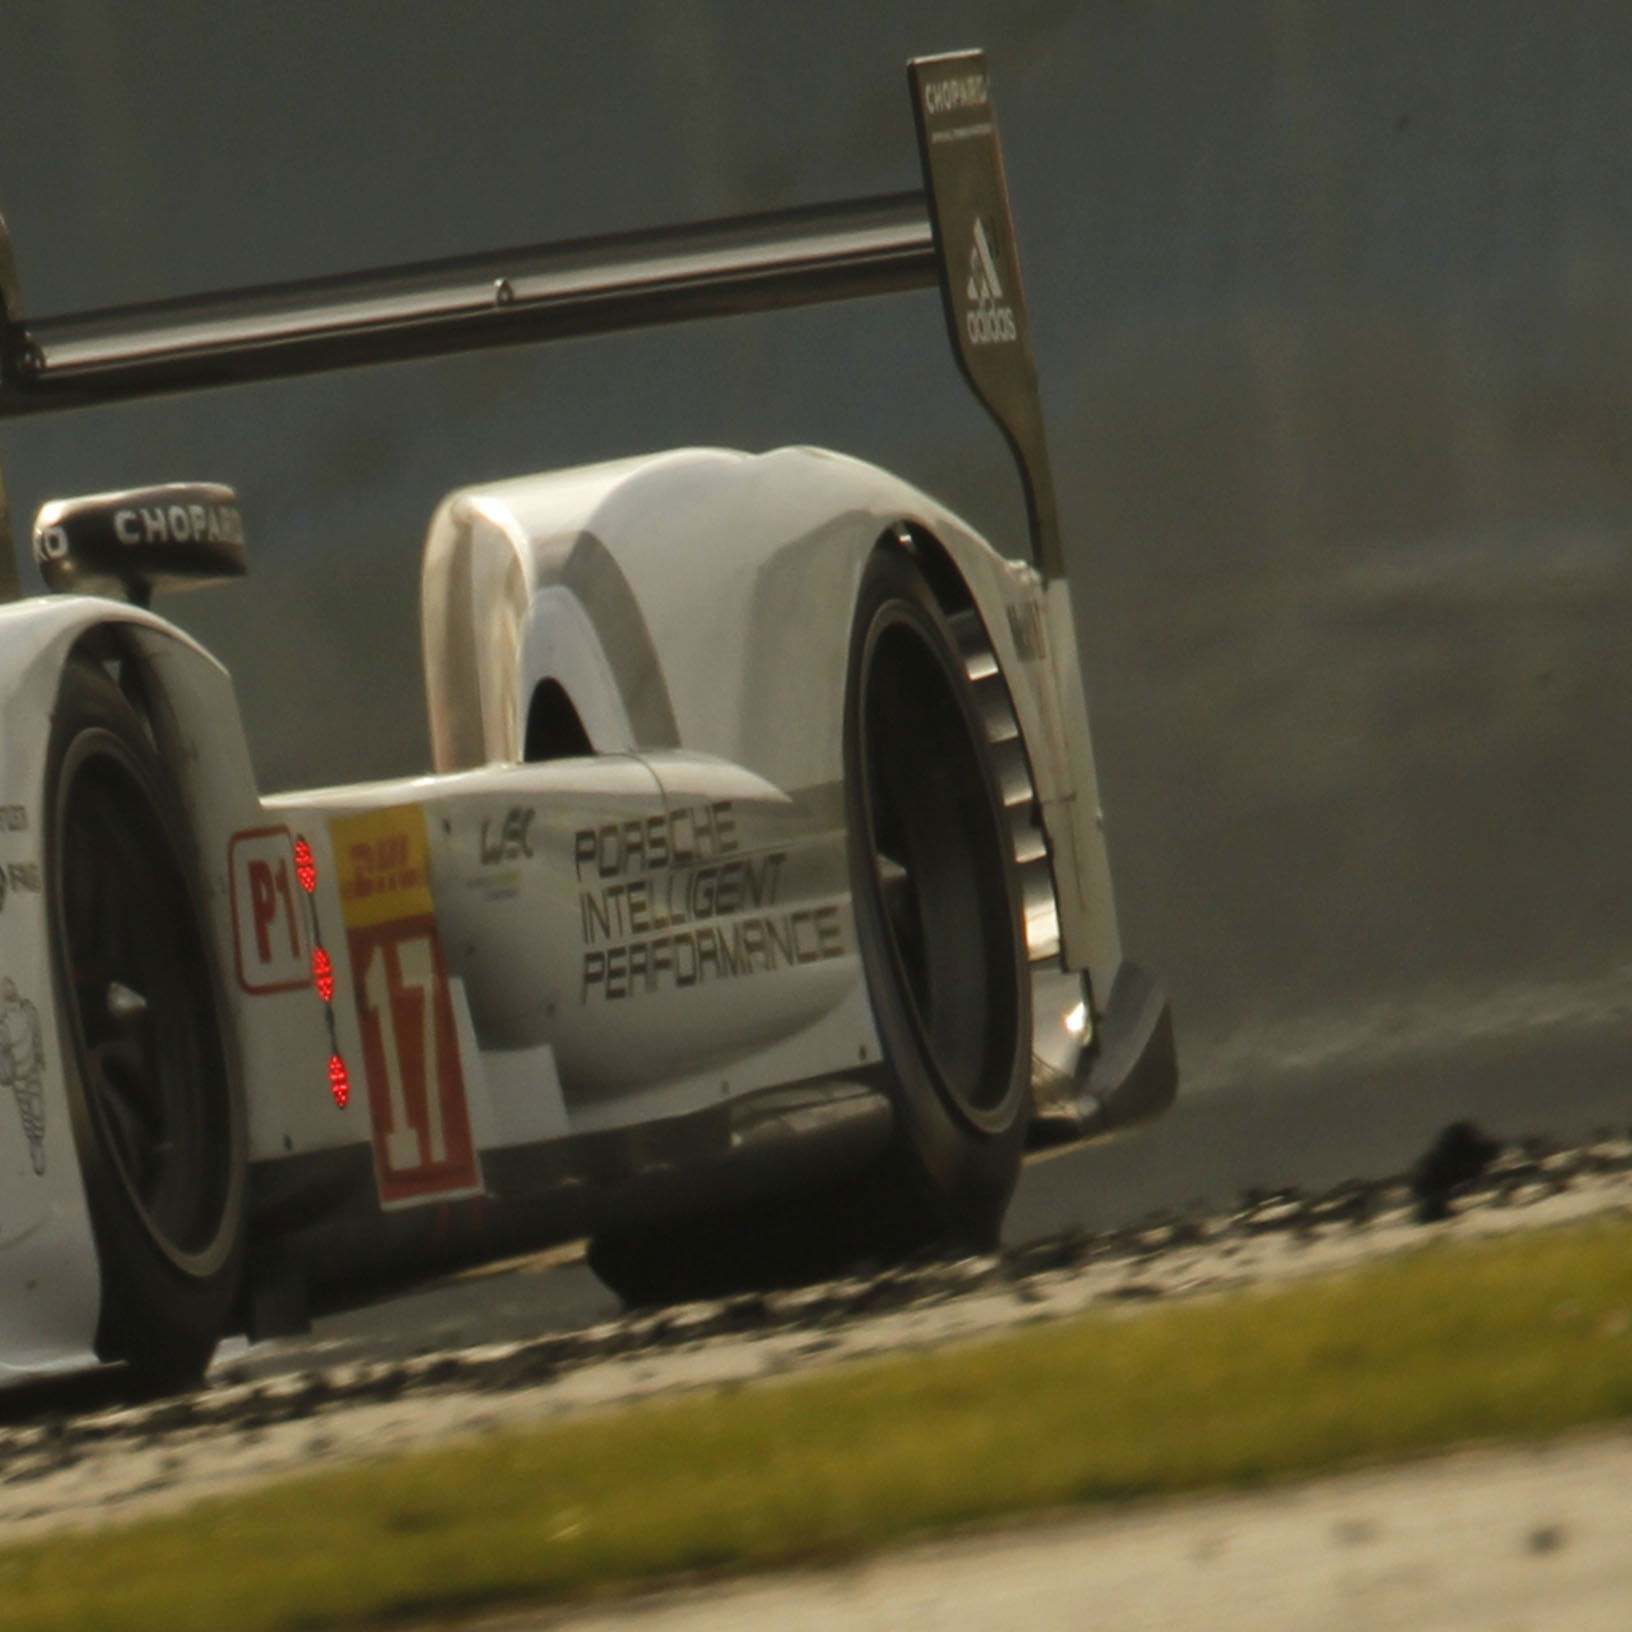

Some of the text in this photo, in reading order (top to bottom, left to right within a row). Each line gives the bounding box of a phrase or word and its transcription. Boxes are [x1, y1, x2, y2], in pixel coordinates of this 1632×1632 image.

[968, 299, 1017, 342] adidas
[575, 801, 739, 883] PORSCHE
[248, 857, 302, 965] P1
[579, 853, 787, 944] INTELLIGENT
[581, 905, 845, 1006] PERFORMANCE
[366, 936, 448, 1172] 17
